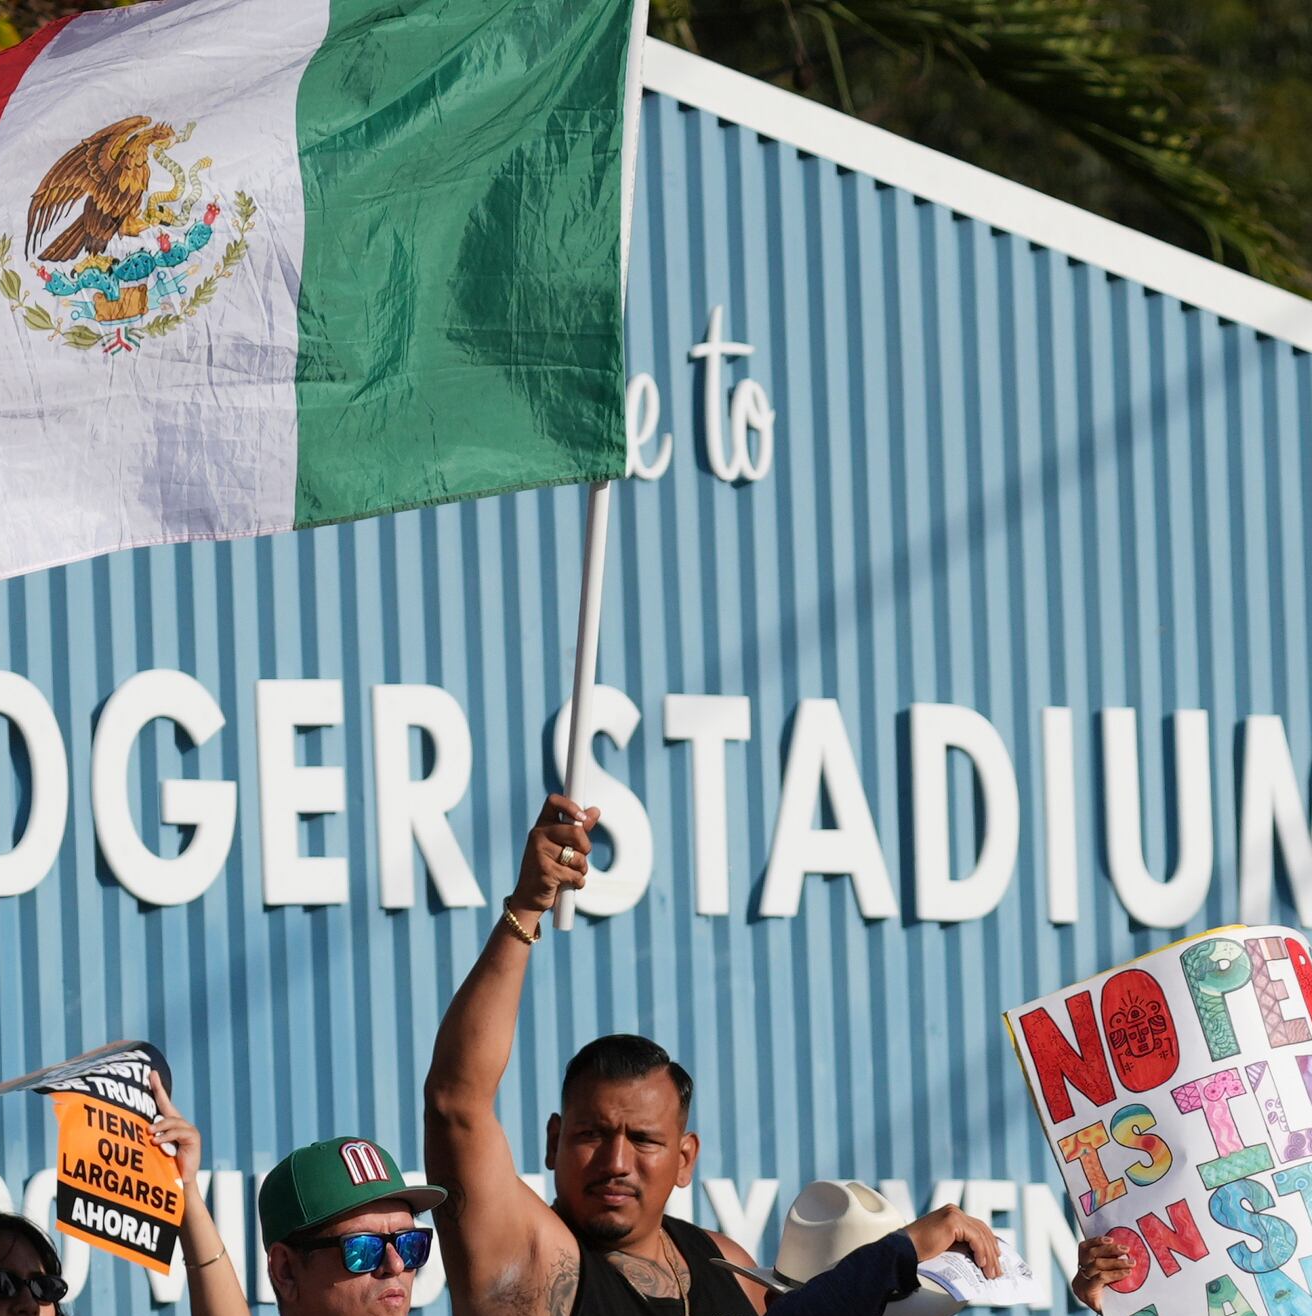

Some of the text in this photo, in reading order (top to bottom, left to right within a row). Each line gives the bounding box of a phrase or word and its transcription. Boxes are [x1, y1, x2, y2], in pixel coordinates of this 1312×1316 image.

[690, 305, 775, 481] to
[1019, 968, 1180, 1123] NO
[83, 1104, 148, 1148] TIENE
[86, 1076, 157, 1119] TRUMP
[62, 1153, 178, 1215] LARGARSE
[98, 1138, 144, 1174] QUE
[1057, 1103, 1172, 1217] IS
[72, 1197, 161, 1252] AHORA!
[1103, 1198, 1209, 1294] ON
